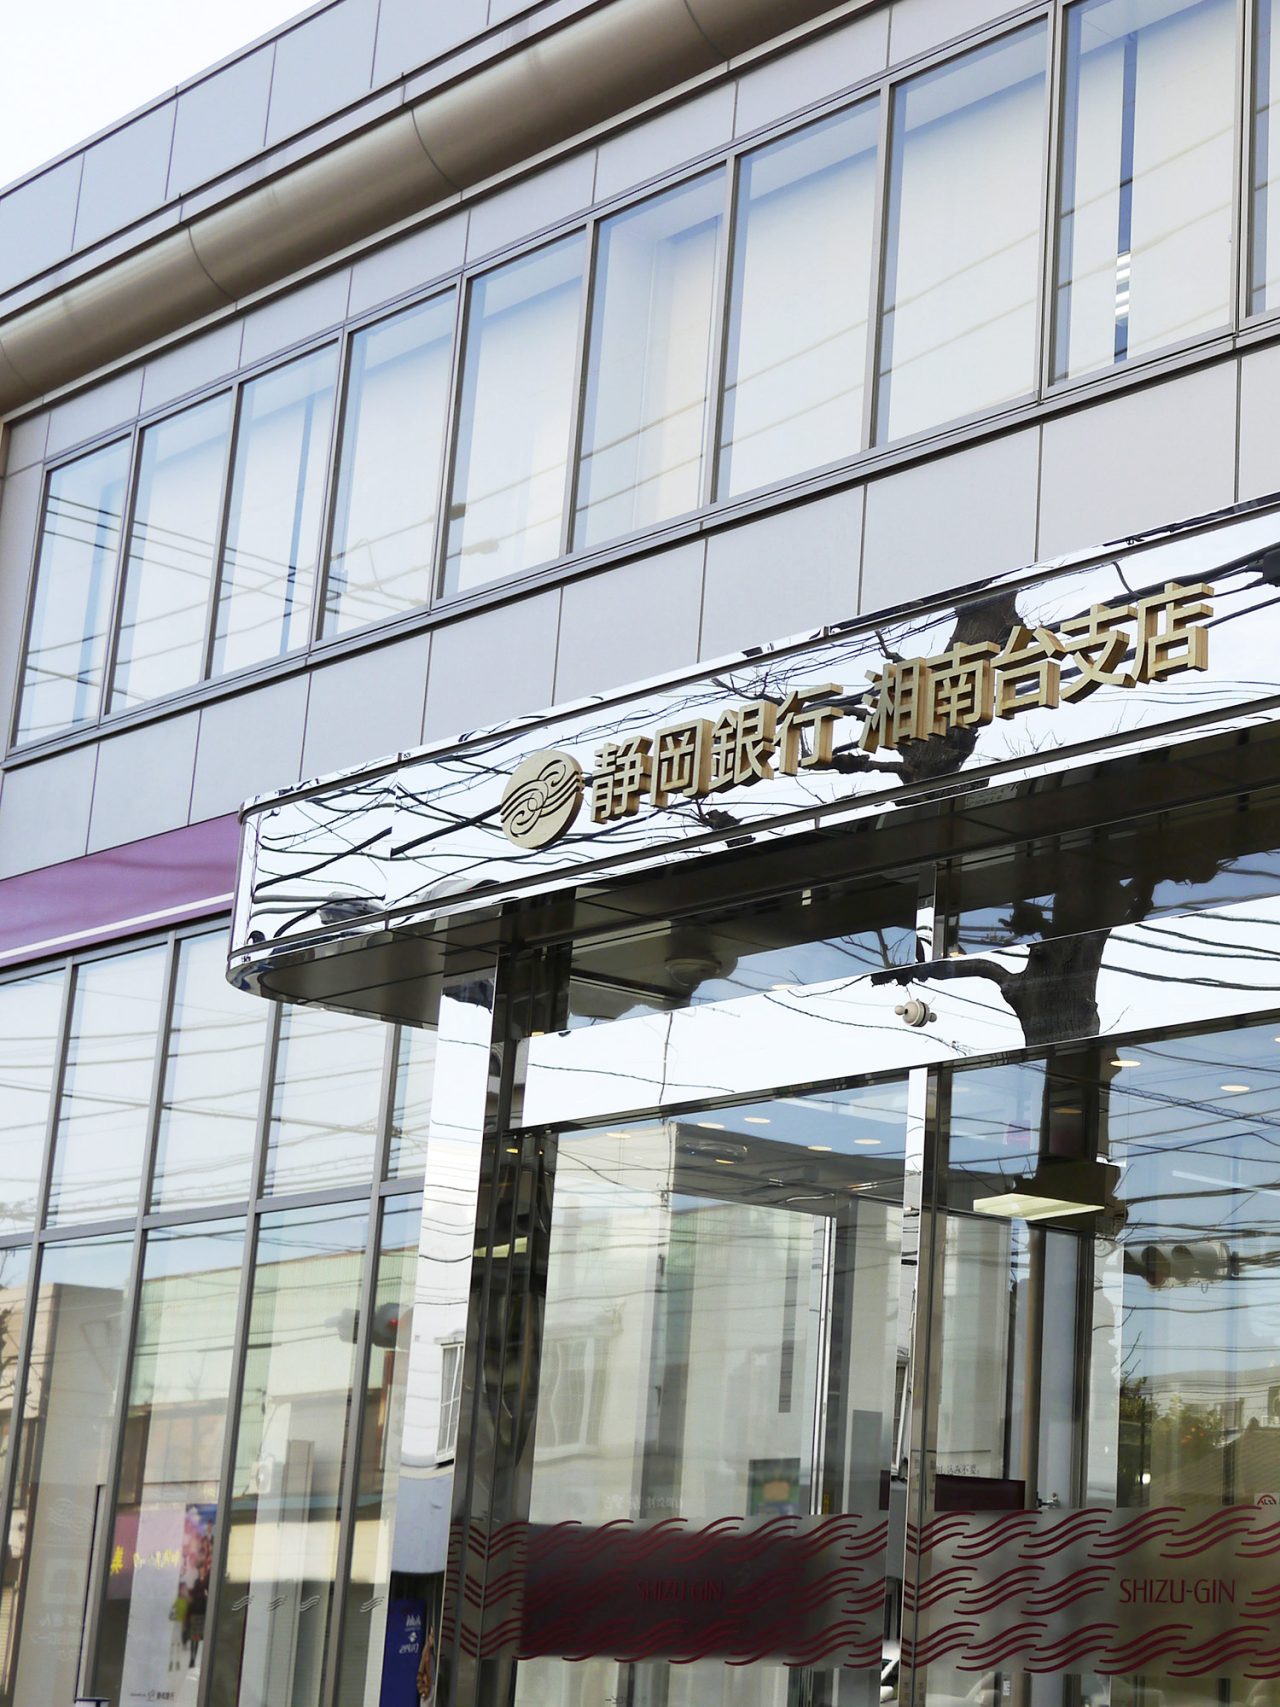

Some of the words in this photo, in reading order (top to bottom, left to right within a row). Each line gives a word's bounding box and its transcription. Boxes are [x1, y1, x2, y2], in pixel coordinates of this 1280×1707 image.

[590, 682, 845, 824] 静岡銀行
[858, 582, 1215, 752] 湘南台支店
[1119, 1578, 1237, 1604] SHIZU-GIN
